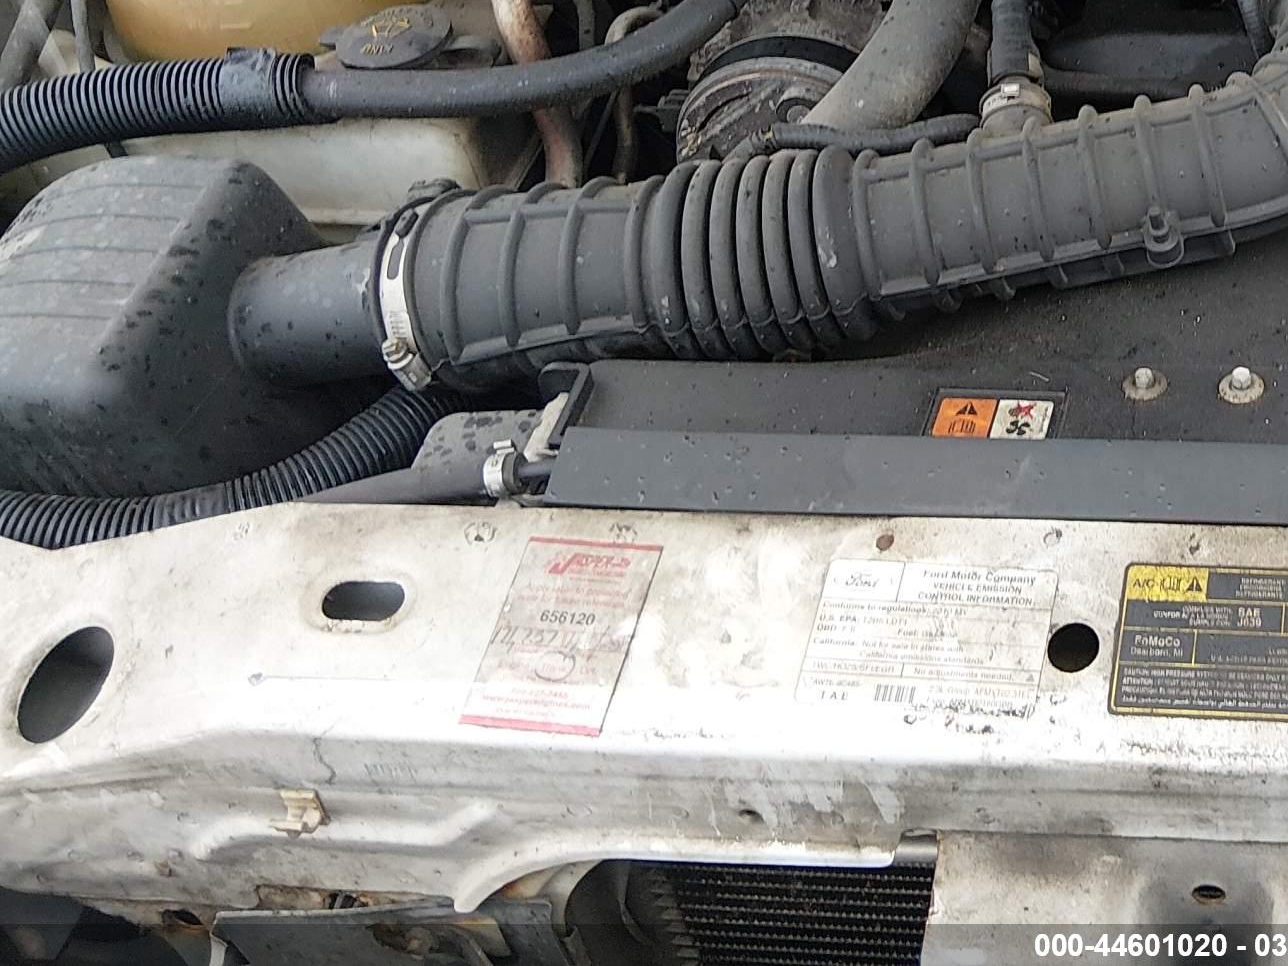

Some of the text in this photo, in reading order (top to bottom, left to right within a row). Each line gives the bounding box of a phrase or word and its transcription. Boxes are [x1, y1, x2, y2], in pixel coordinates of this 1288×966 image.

[924, 570, 1036, 586] Ford Motor Company
[1133, 578, 1155, 588] A/C
[934, 583, 1022, 594] VEHICLE EMISSION
[918, 592, 964, 601] CONTROL
[540, 610, 596, 626] 656120
[1135, 635, 1180, 646] FoMoCo
